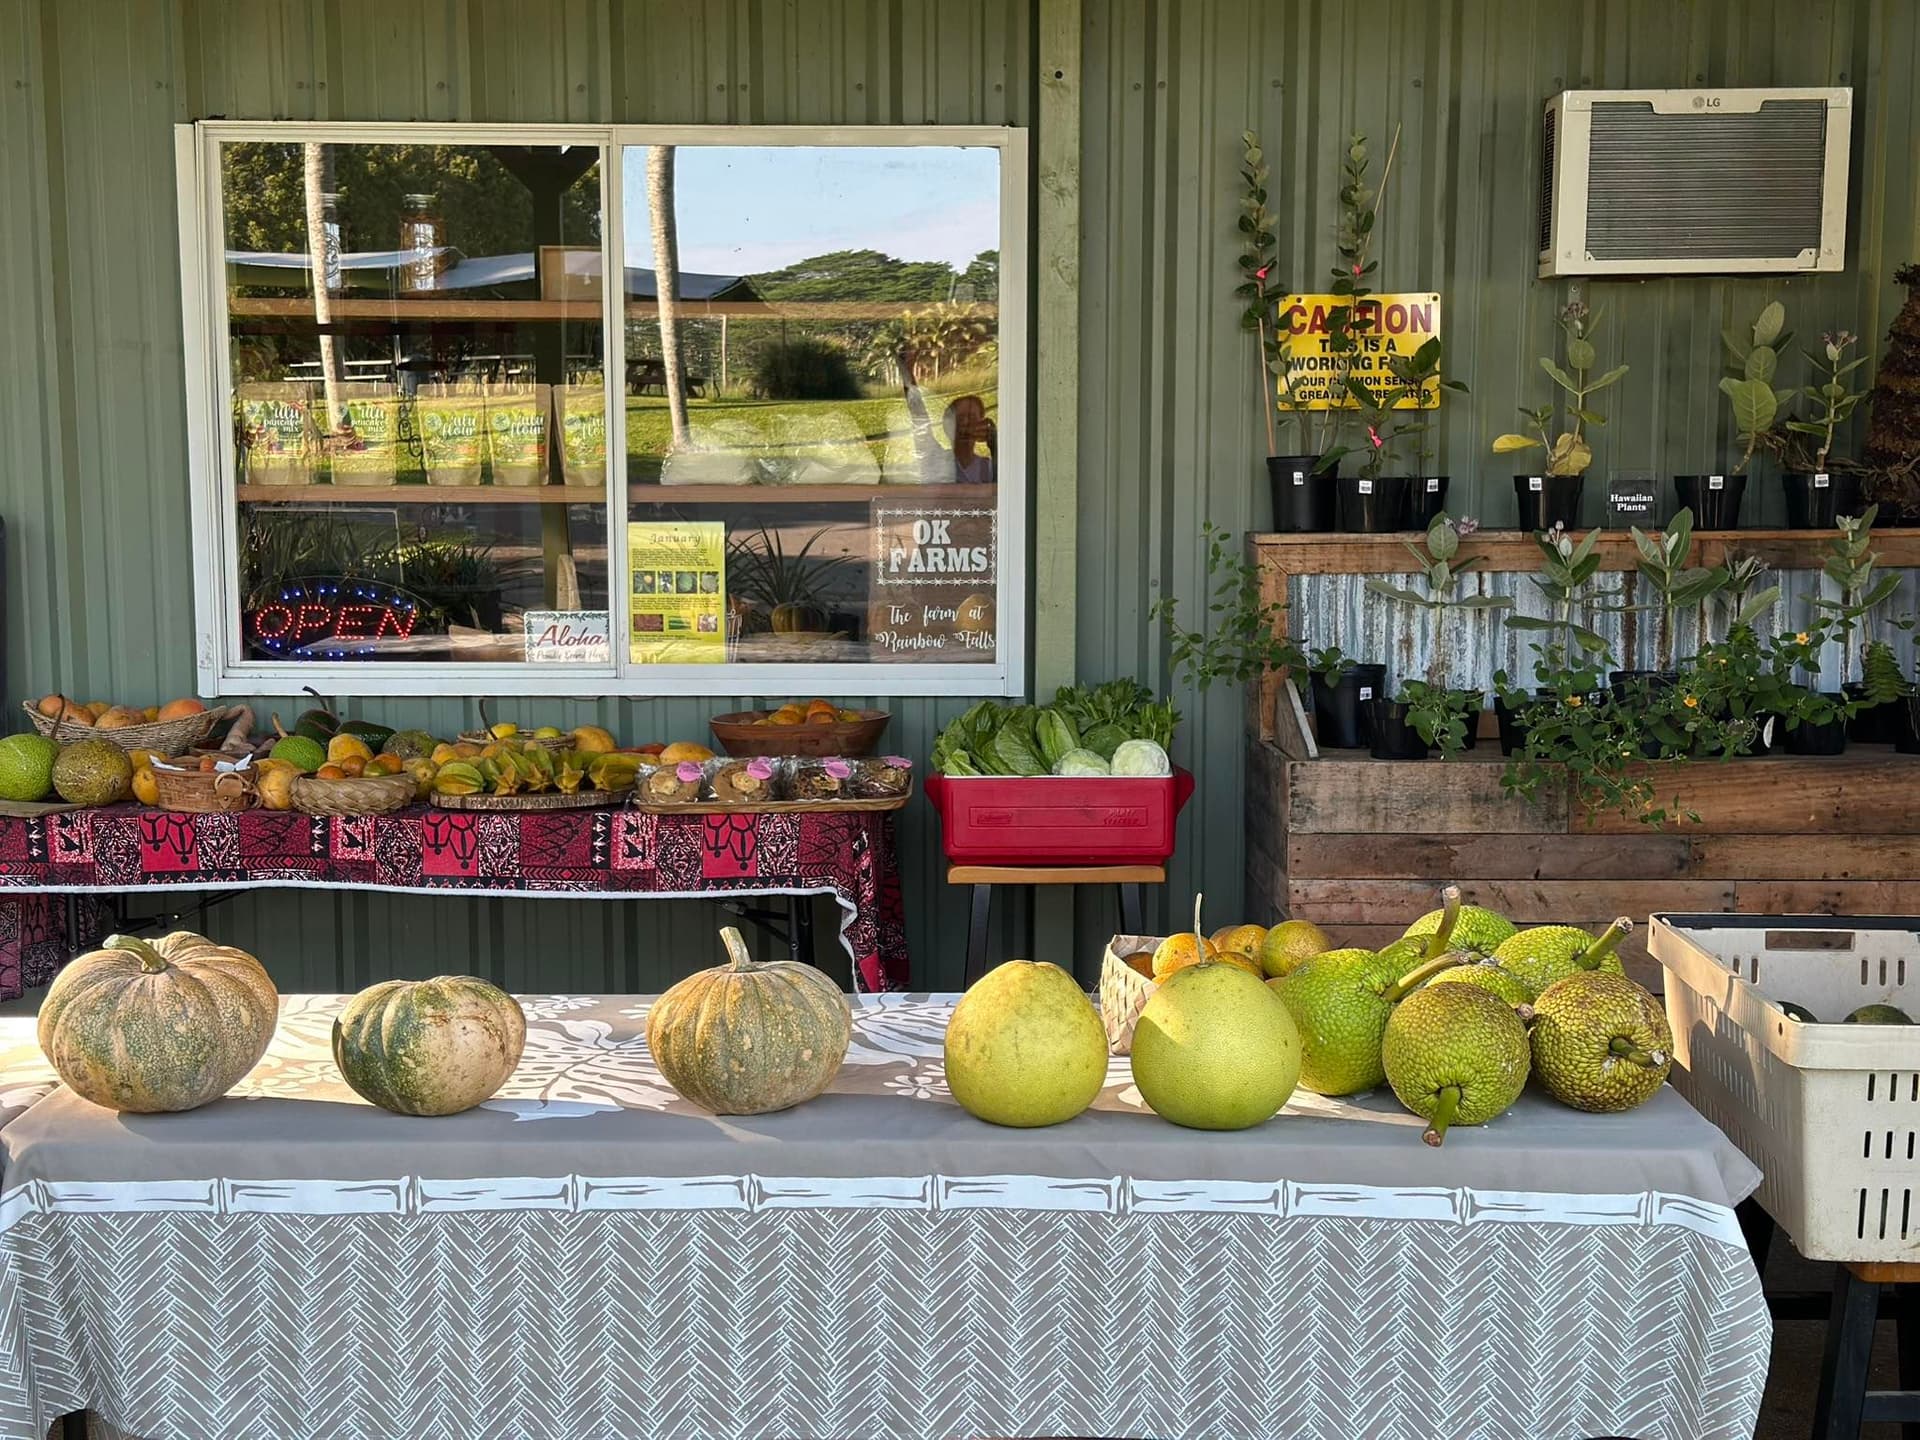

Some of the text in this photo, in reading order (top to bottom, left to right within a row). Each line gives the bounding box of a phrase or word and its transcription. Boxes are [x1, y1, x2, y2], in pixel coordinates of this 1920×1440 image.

[1706, 97, 1721, 108] LG
[1288, 303, 1431, 335] CATION
[1319, 338, 1397, 352] TS IS A
[1294, 377, 1325, 387] OUR
[1610, 493, 1654, 503] Hawaiian
[1616, 502, 1647, 512] Plants
[649, 533, 701, 548] January
[912, 519, 952, 545] OK
[889, 547, 988, 573] FARMS
[255, 604, 418, 641] OPEN
[887, 603, 989, 628] The farm at
[537, 624, 607, 647] Aloha
[875, 629, 996, 653] Rainbow Falls
